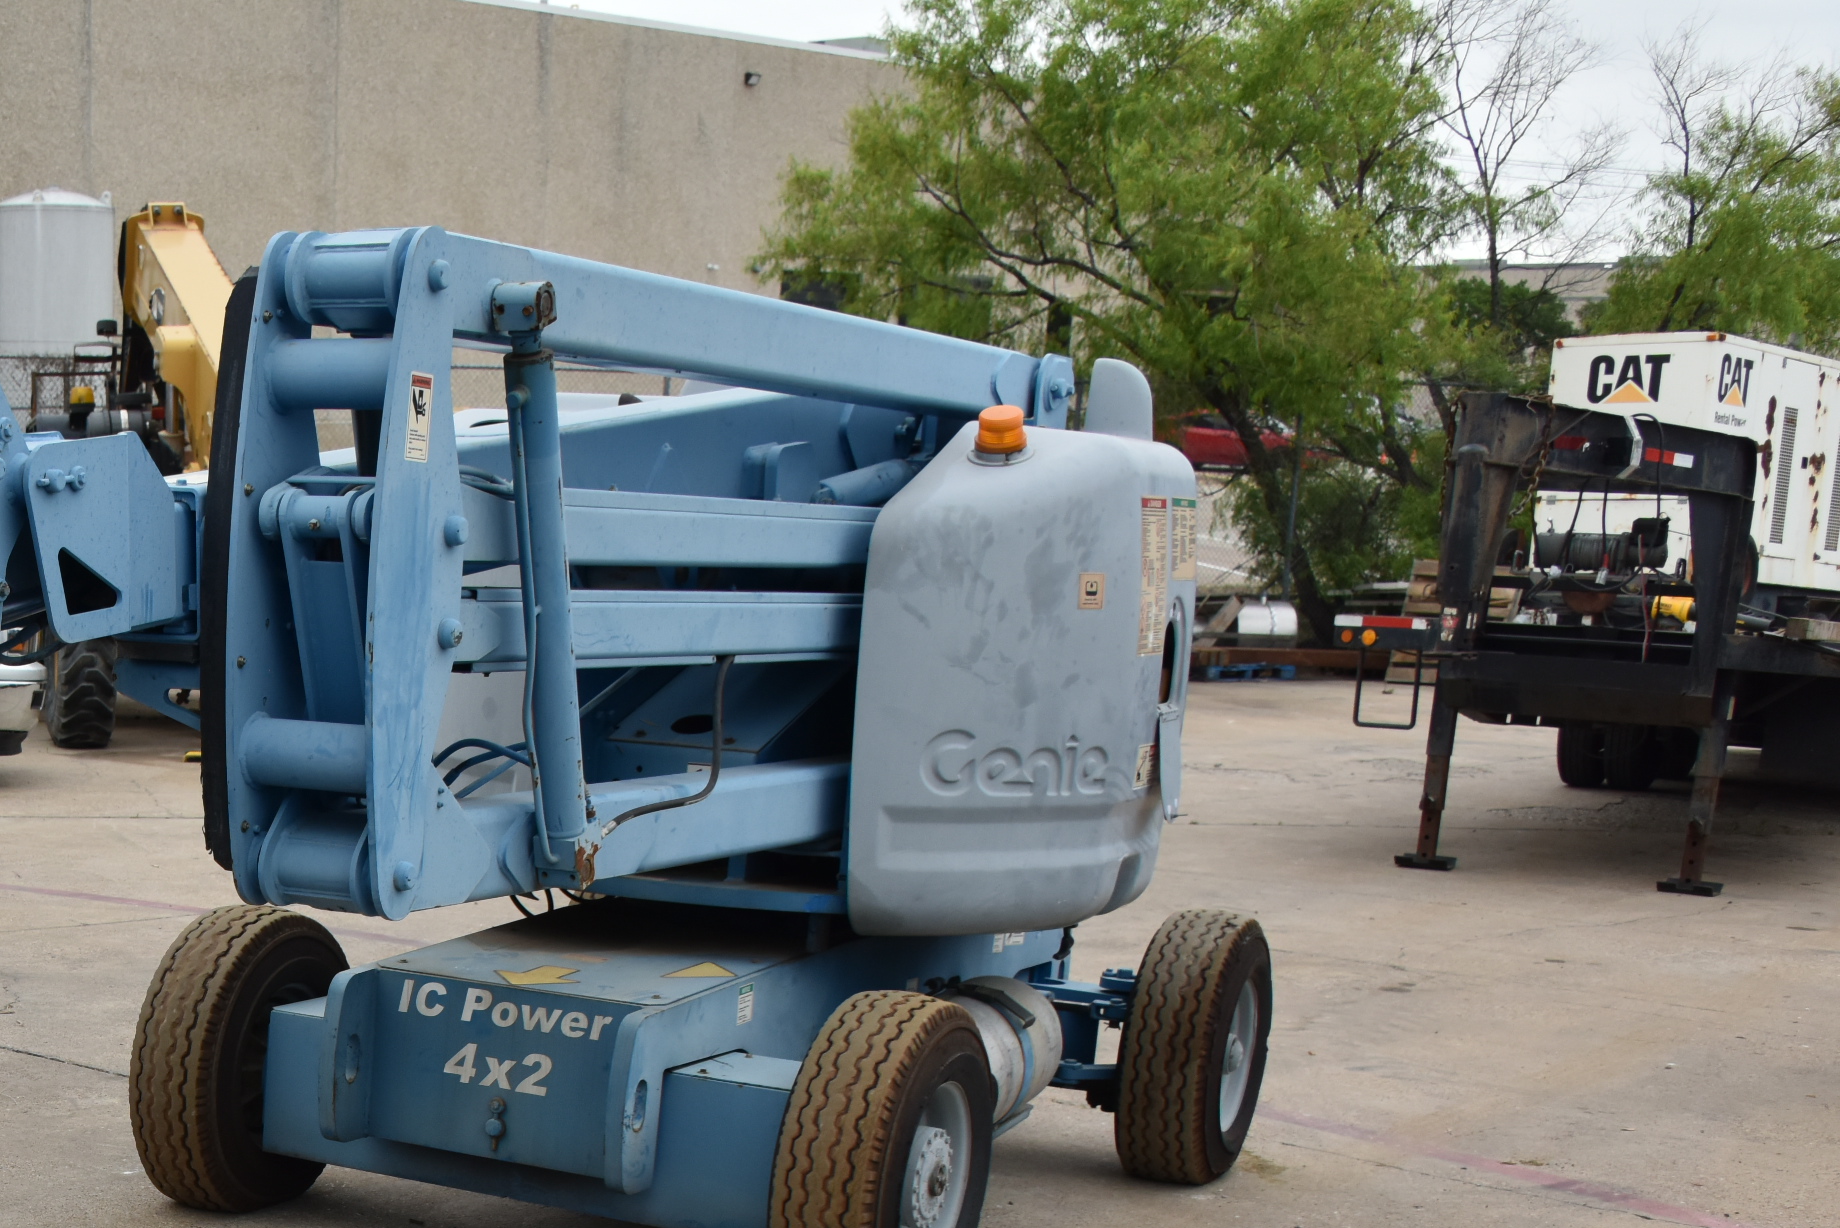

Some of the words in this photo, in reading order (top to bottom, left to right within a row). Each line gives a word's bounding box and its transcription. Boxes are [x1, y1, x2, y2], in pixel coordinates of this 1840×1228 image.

[1586, 354, 1672, 404] CAT
[1718, 353, 1754, 408] CAT
[1714, 412, 1730, 424] Rental
[1731, 415, 1746, 427] Power
[919, 729, 1109, 797] Genie
[398, 979, 448, 1017] IC
[460, 987, 613, 1041] Power
[443, 1042, 553, 1097] 4x2
